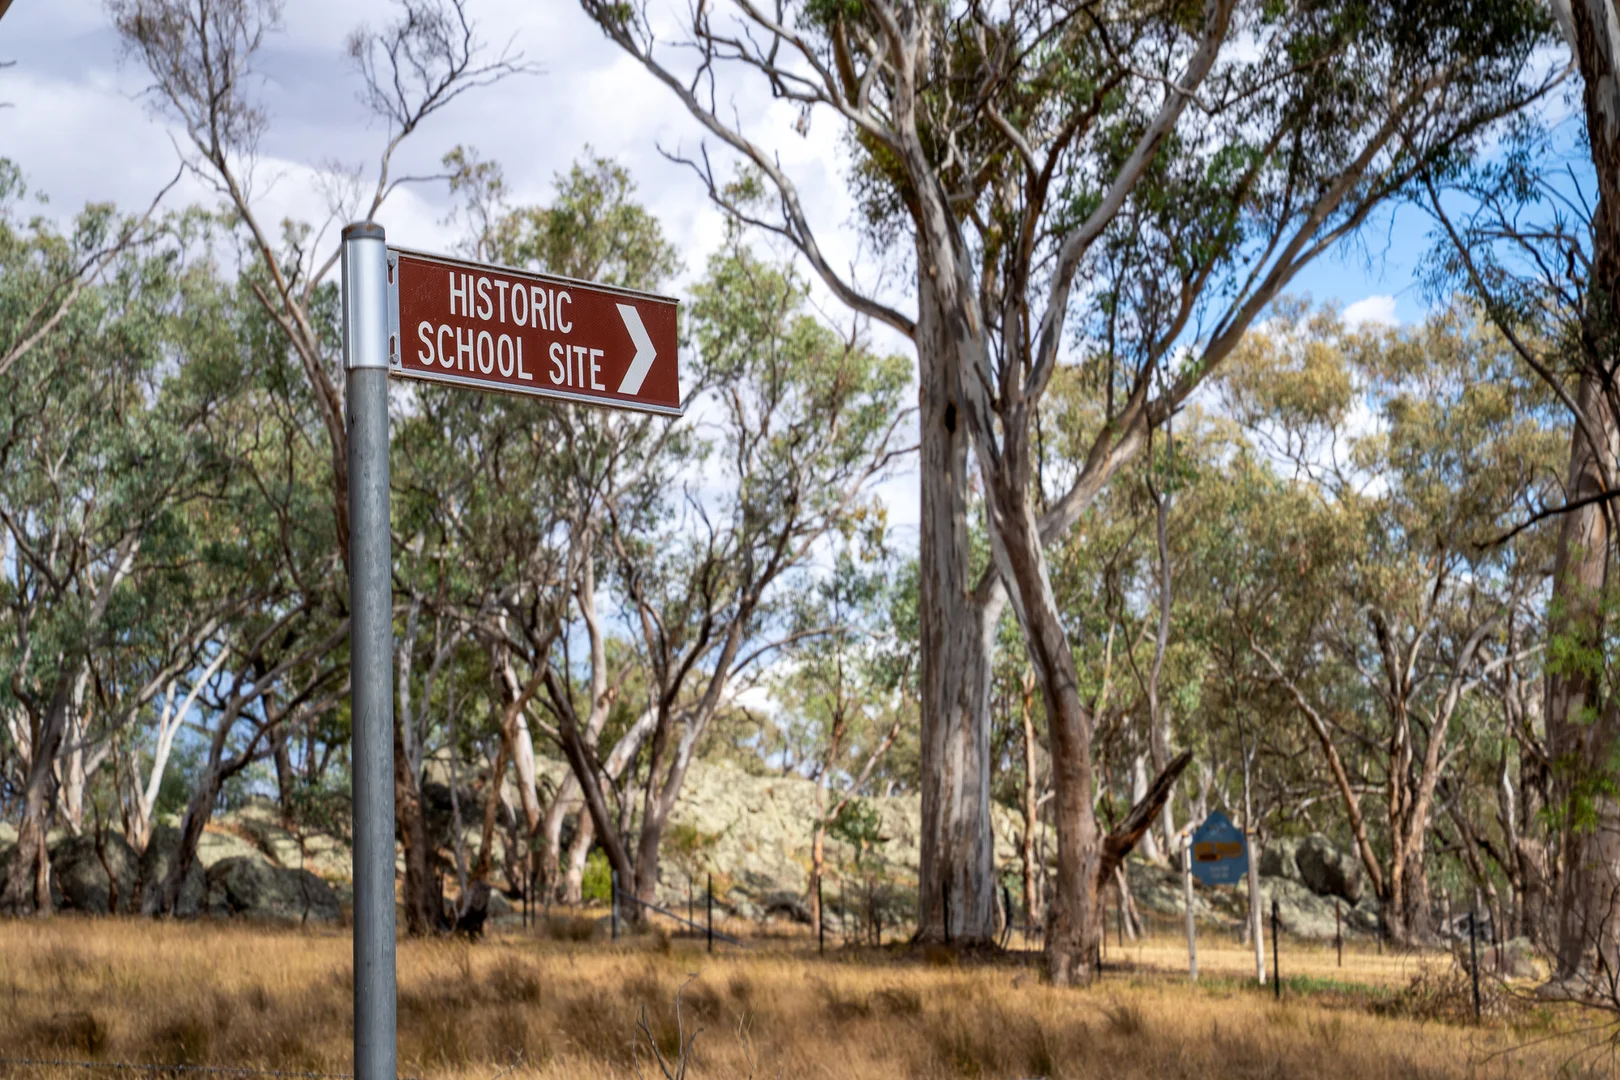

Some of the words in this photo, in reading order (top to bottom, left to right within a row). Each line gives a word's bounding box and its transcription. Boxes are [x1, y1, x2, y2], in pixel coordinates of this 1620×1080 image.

[449, 271, 573, 334] HISTORIC
[417, 320, 533, 381] SCHOOL
[549, 341, 606, 392] SITE
